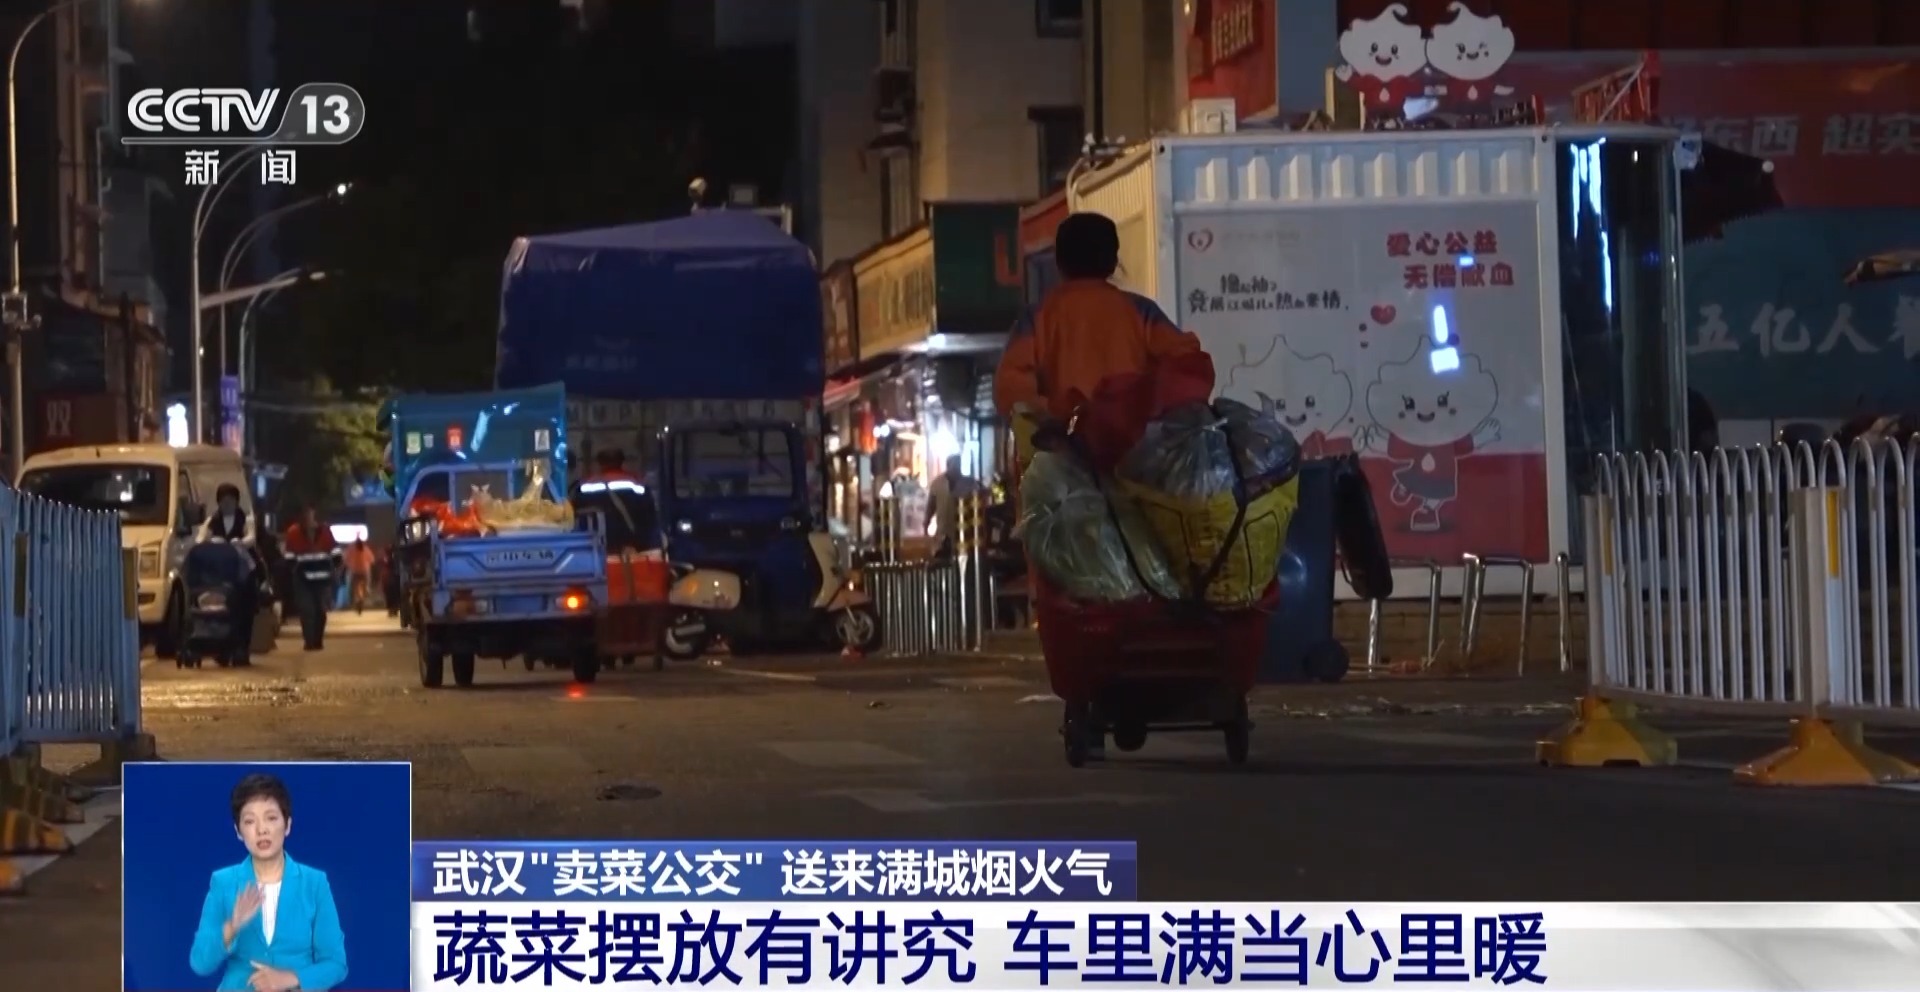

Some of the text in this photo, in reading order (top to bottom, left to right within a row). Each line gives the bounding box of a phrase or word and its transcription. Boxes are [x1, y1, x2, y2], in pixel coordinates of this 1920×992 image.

[1387, 230, 1497, 257] 爱心公益
[1404, 262, 1513, 289] 无偿献血
